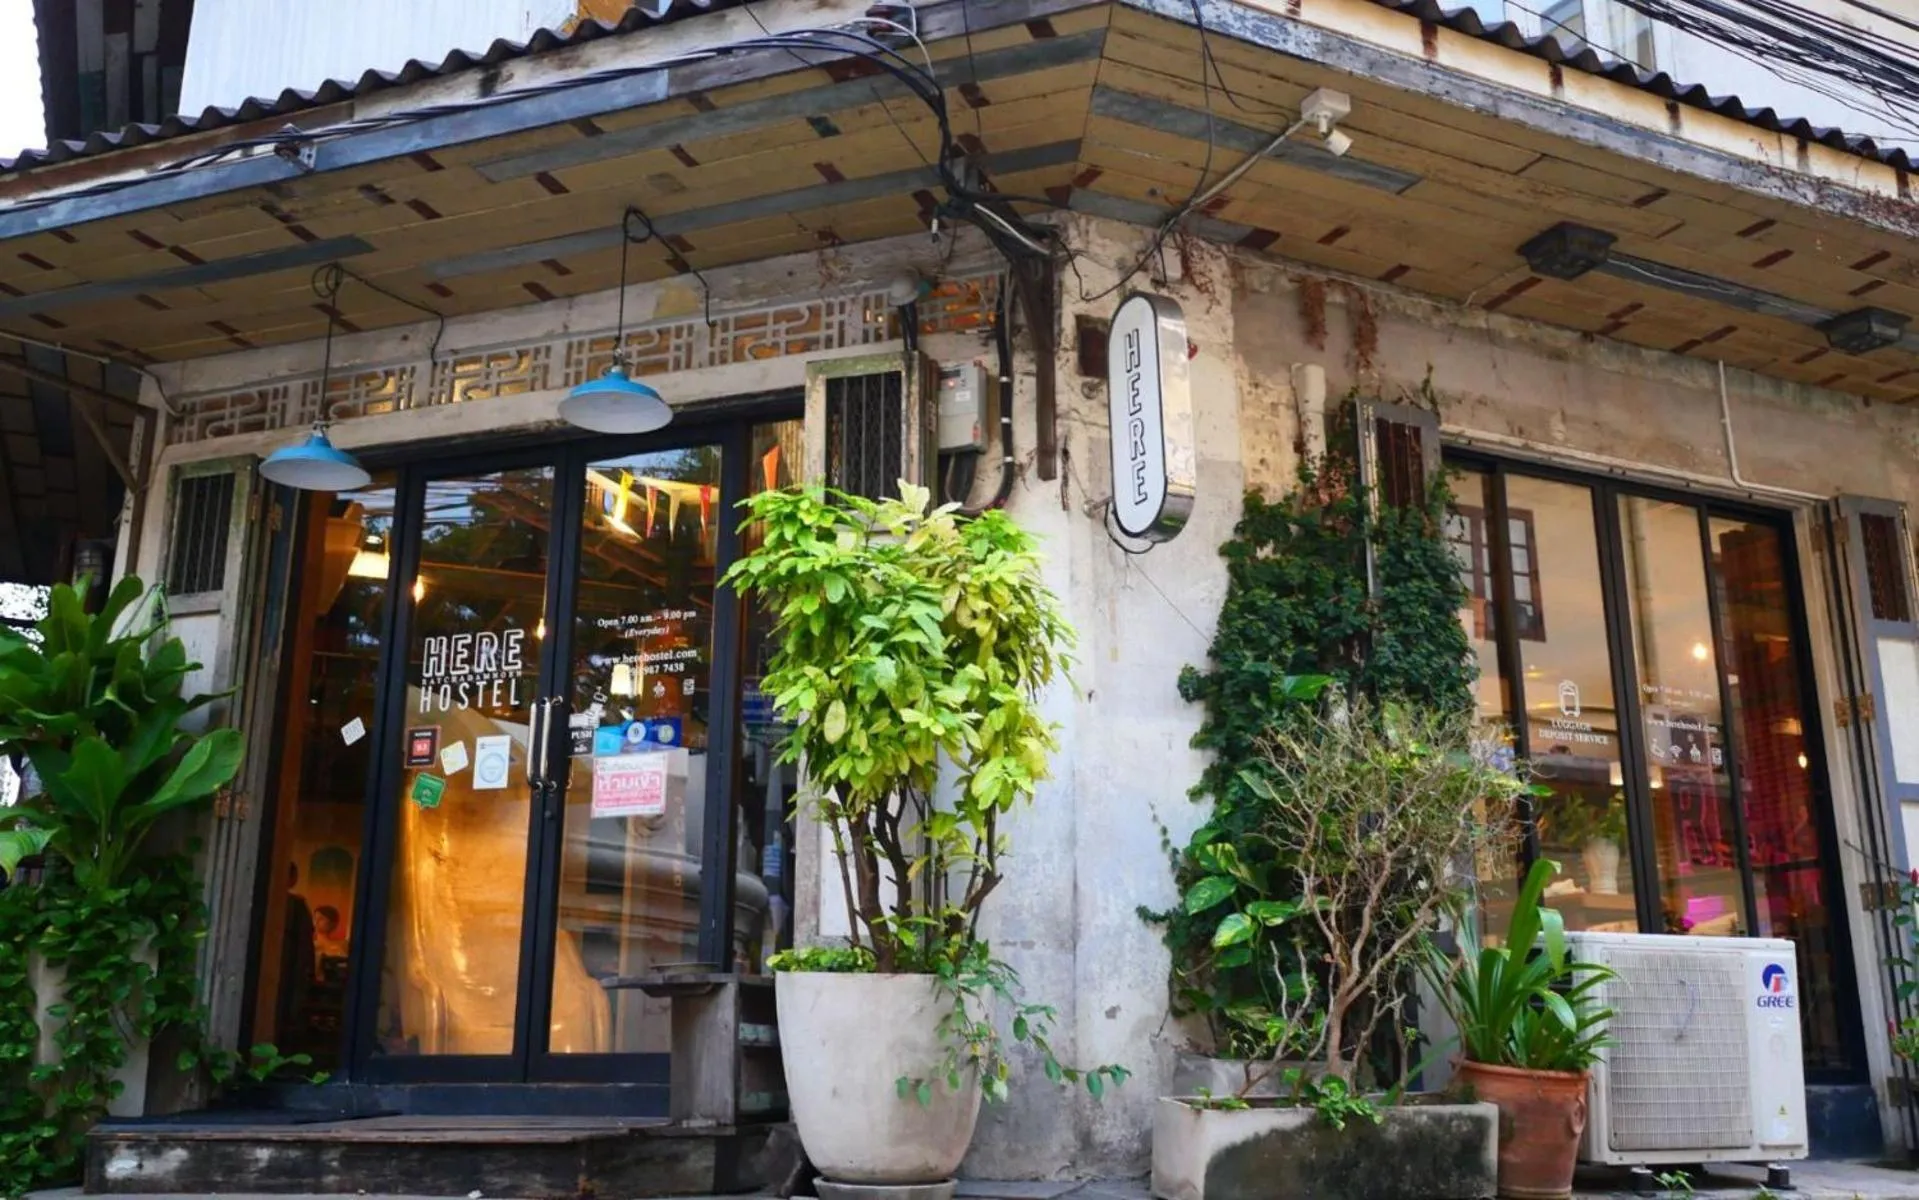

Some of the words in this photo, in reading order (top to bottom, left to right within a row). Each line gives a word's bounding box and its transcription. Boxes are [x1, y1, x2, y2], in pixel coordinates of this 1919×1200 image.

[1123, 328, 1149, 506] HERE
[597, 617, 619, 629] Open
[683, 609, 697, 620] pm
[624, 625, 670, 639] (Everyday)
[422, 629, 525, 677] HERE
[663, 662, 685, 673] 7438
[420, 679, 521, 714] HOSTEL
[1757, 995, 1795, 1009] GREE
